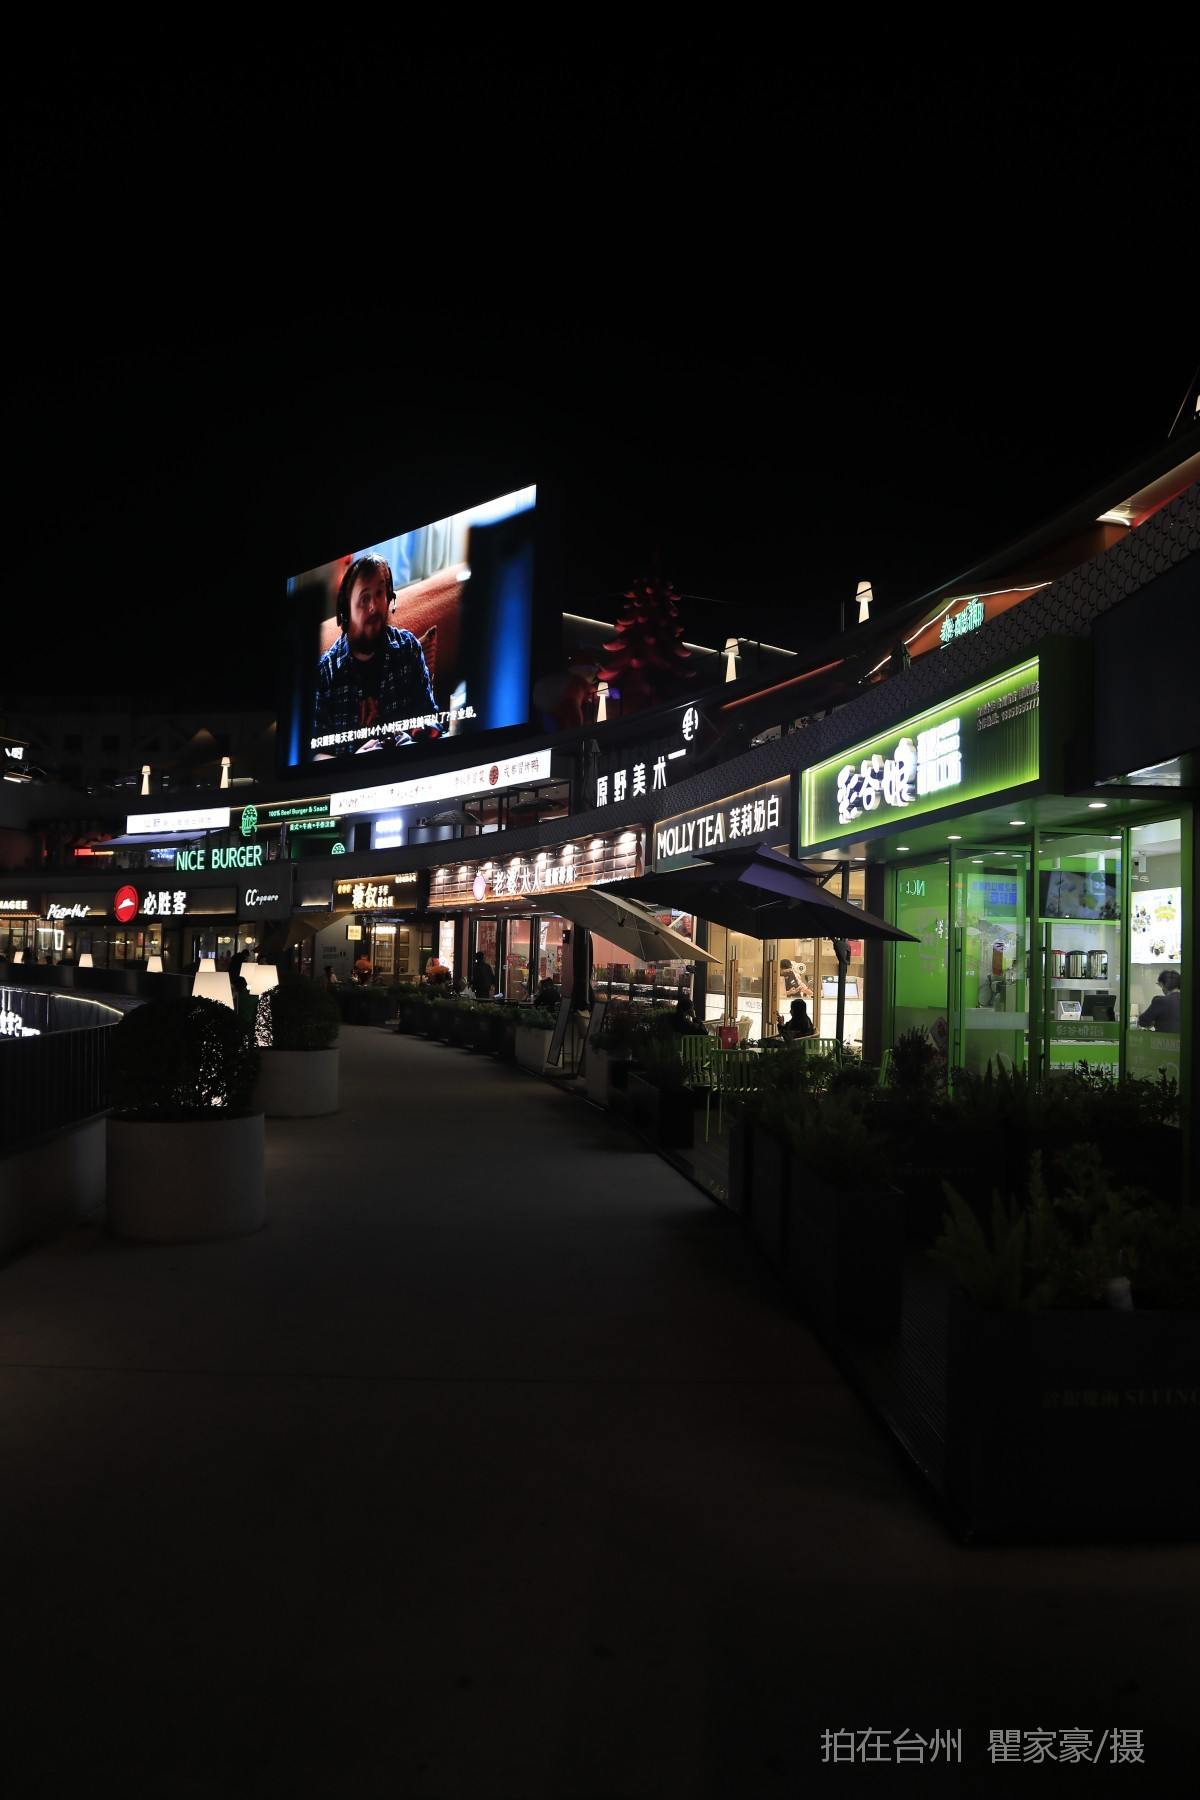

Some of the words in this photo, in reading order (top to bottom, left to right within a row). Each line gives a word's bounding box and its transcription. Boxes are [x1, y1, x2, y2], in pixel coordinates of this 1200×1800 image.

[729, 795, 780, 839] 茉莉奶白
[657, 820, 696, 860] MOLLY
[697, 812, 724, 848] TEA
[176, 850, 205, 871] NICE
[211, 845, 262, 869] BURGER
[143, 890, 187, 915] 必胜客
